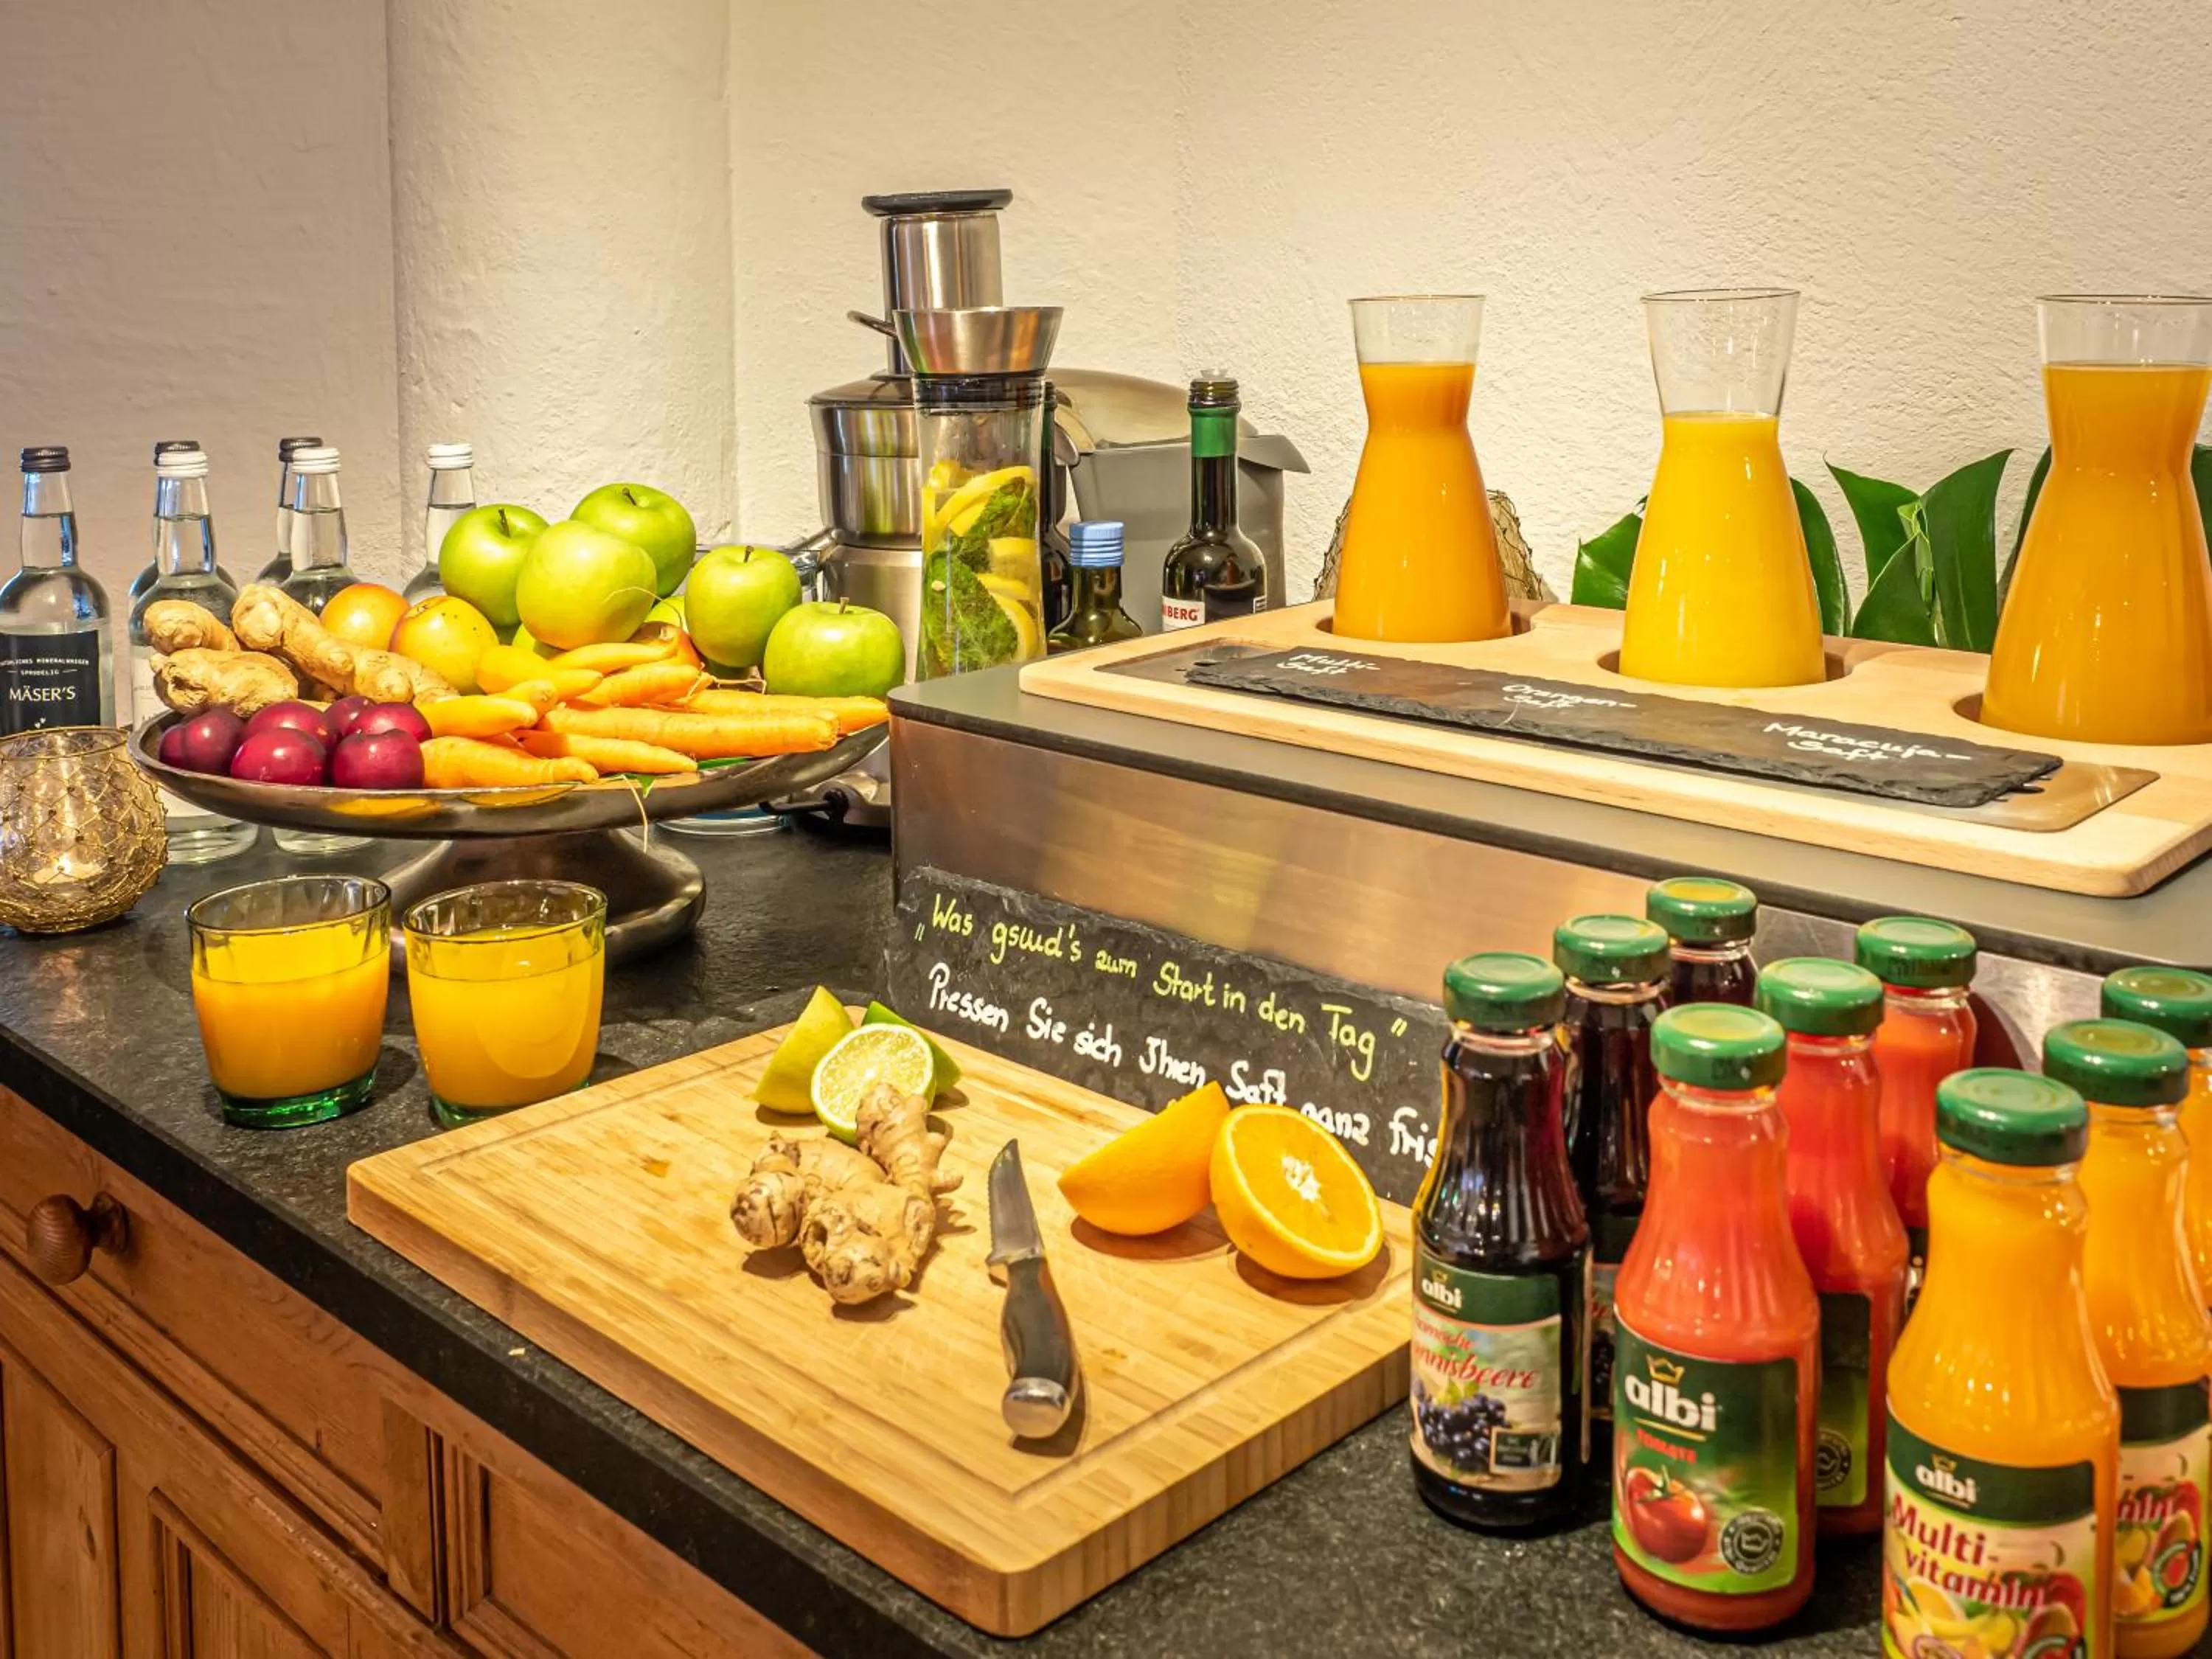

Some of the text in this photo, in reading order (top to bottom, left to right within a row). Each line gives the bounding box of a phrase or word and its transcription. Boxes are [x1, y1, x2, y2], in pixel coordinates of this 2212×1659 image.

[9, 685, 77, 701] MÄSER'S
[928, 961, 1010, 1033] Pressen
[1026, 996, 1068, 1043] Sie
[1073, 1021, 1123, 1068] sich
[1225, 1060, 1287, 1107] Saft
[1152, 961, 1216, 1006] Start
[1223, 982, 1246, 1014] in
[1258, 991, 1306, 1034] den
[1321, 1002, 1376, 1082] Tag
[1421, 1278, 1463, 1310] albi
[1624, 1373, 1717, 1432] albi
[1915, 1463, 1978, 1504] albi
[1905, 1545, 2045, 1609] vitamin
